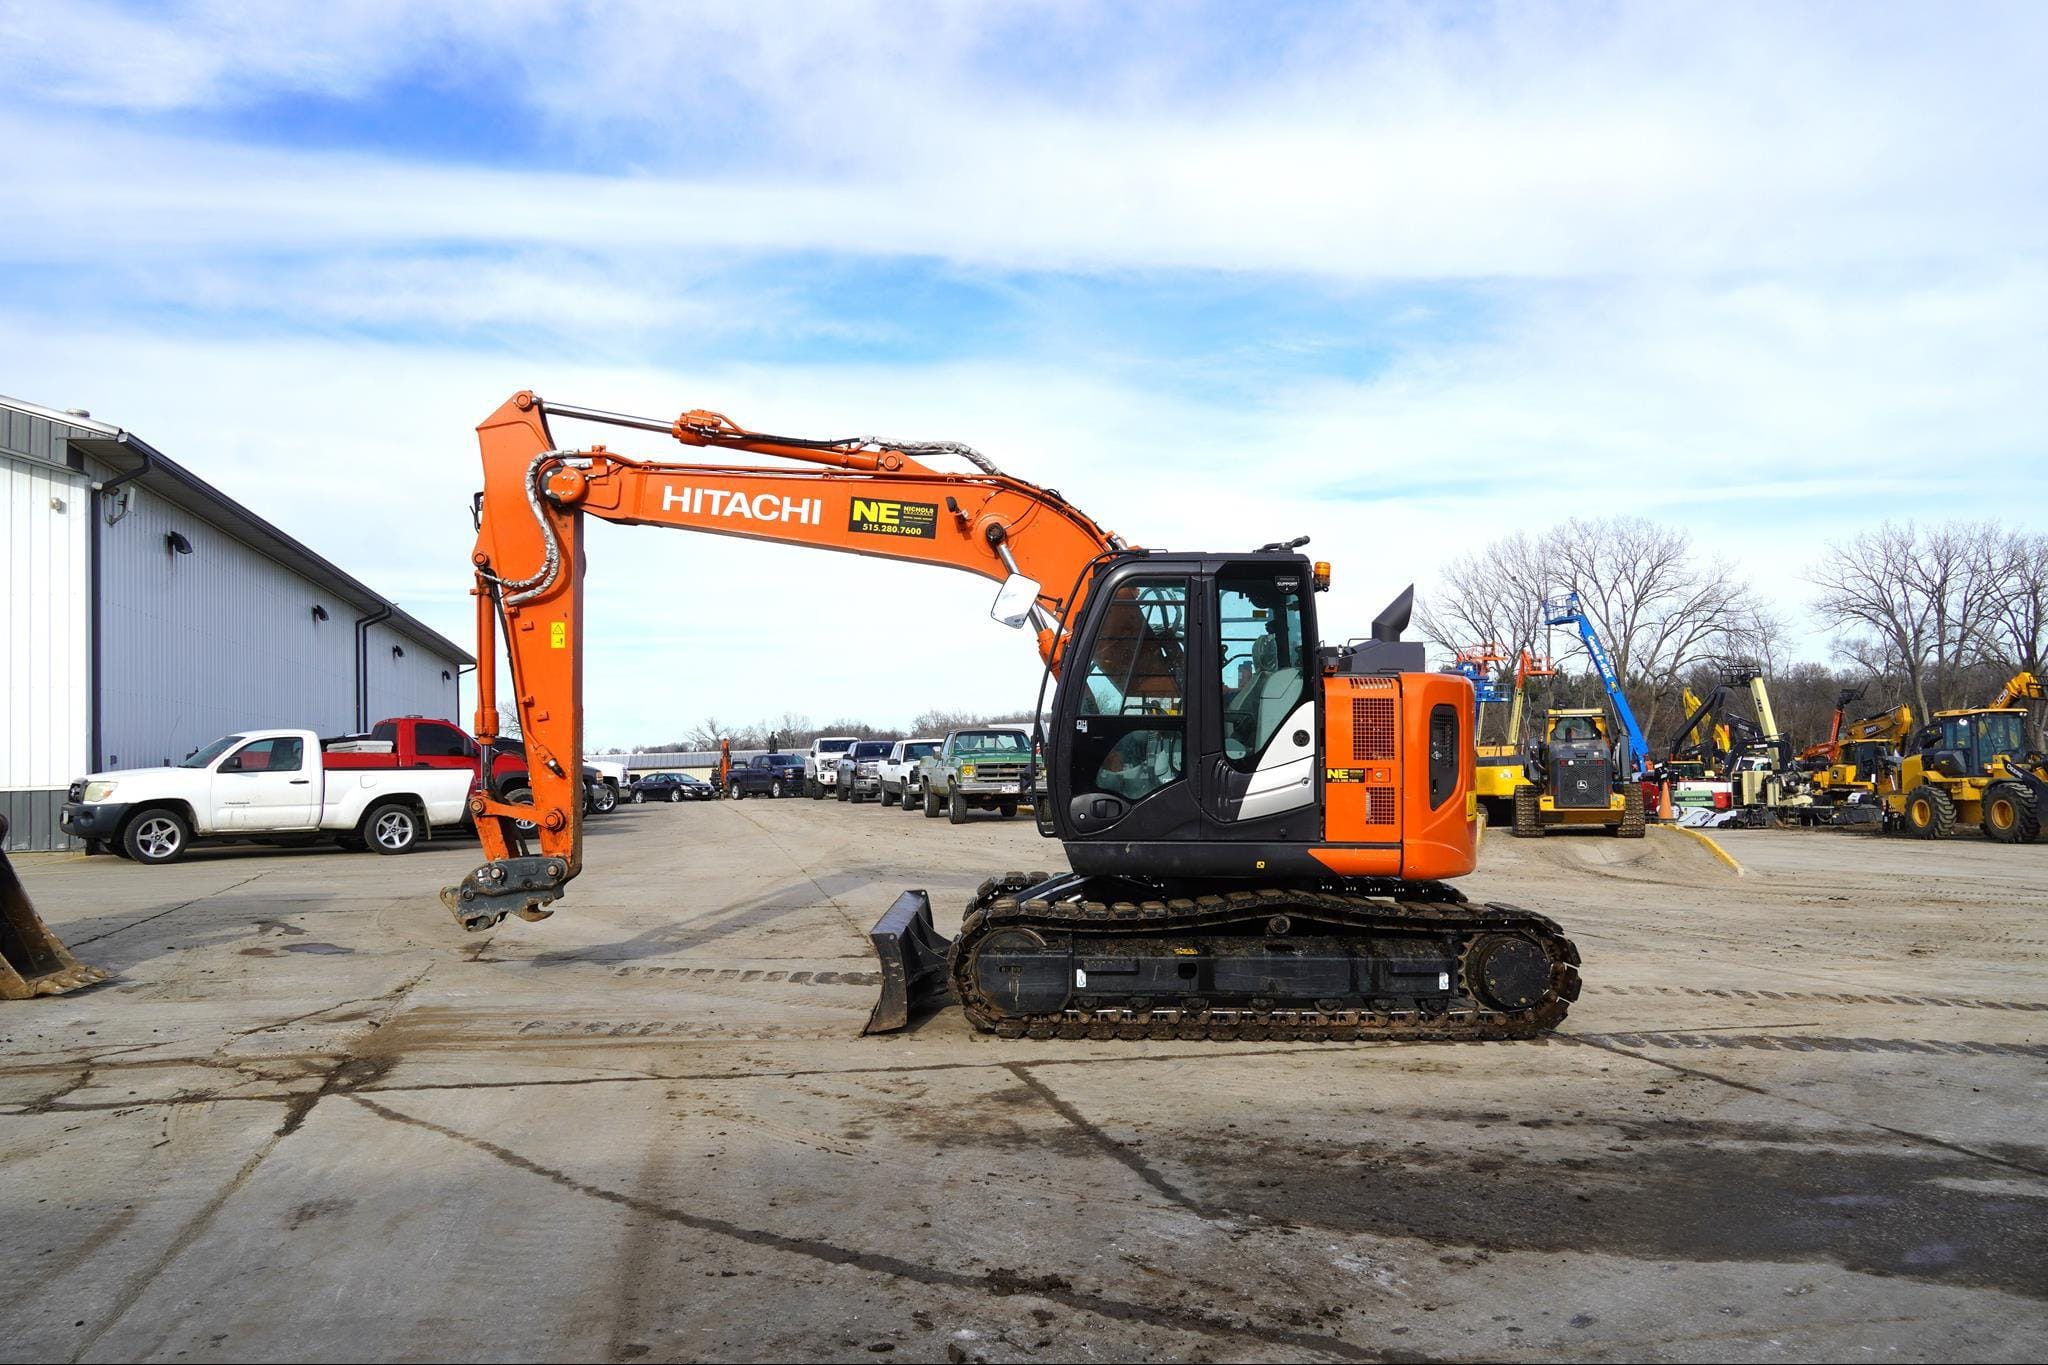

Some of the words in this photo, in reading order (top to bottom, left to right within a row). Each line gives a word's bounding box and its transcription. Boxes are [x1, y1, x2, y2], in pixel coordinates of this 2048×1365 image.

[662, 485, 822, 525] HITACHI
[852, 500, 901, 524] NE
[903, 505, 934, 514] NICHOLS
[862, 523, 922, 535] 515.280.7600
[1995, 688, 2009, 706] JCB
[1327, 769, 1349, 778] NE
[2006, 763, 2024, 778] DEERE
